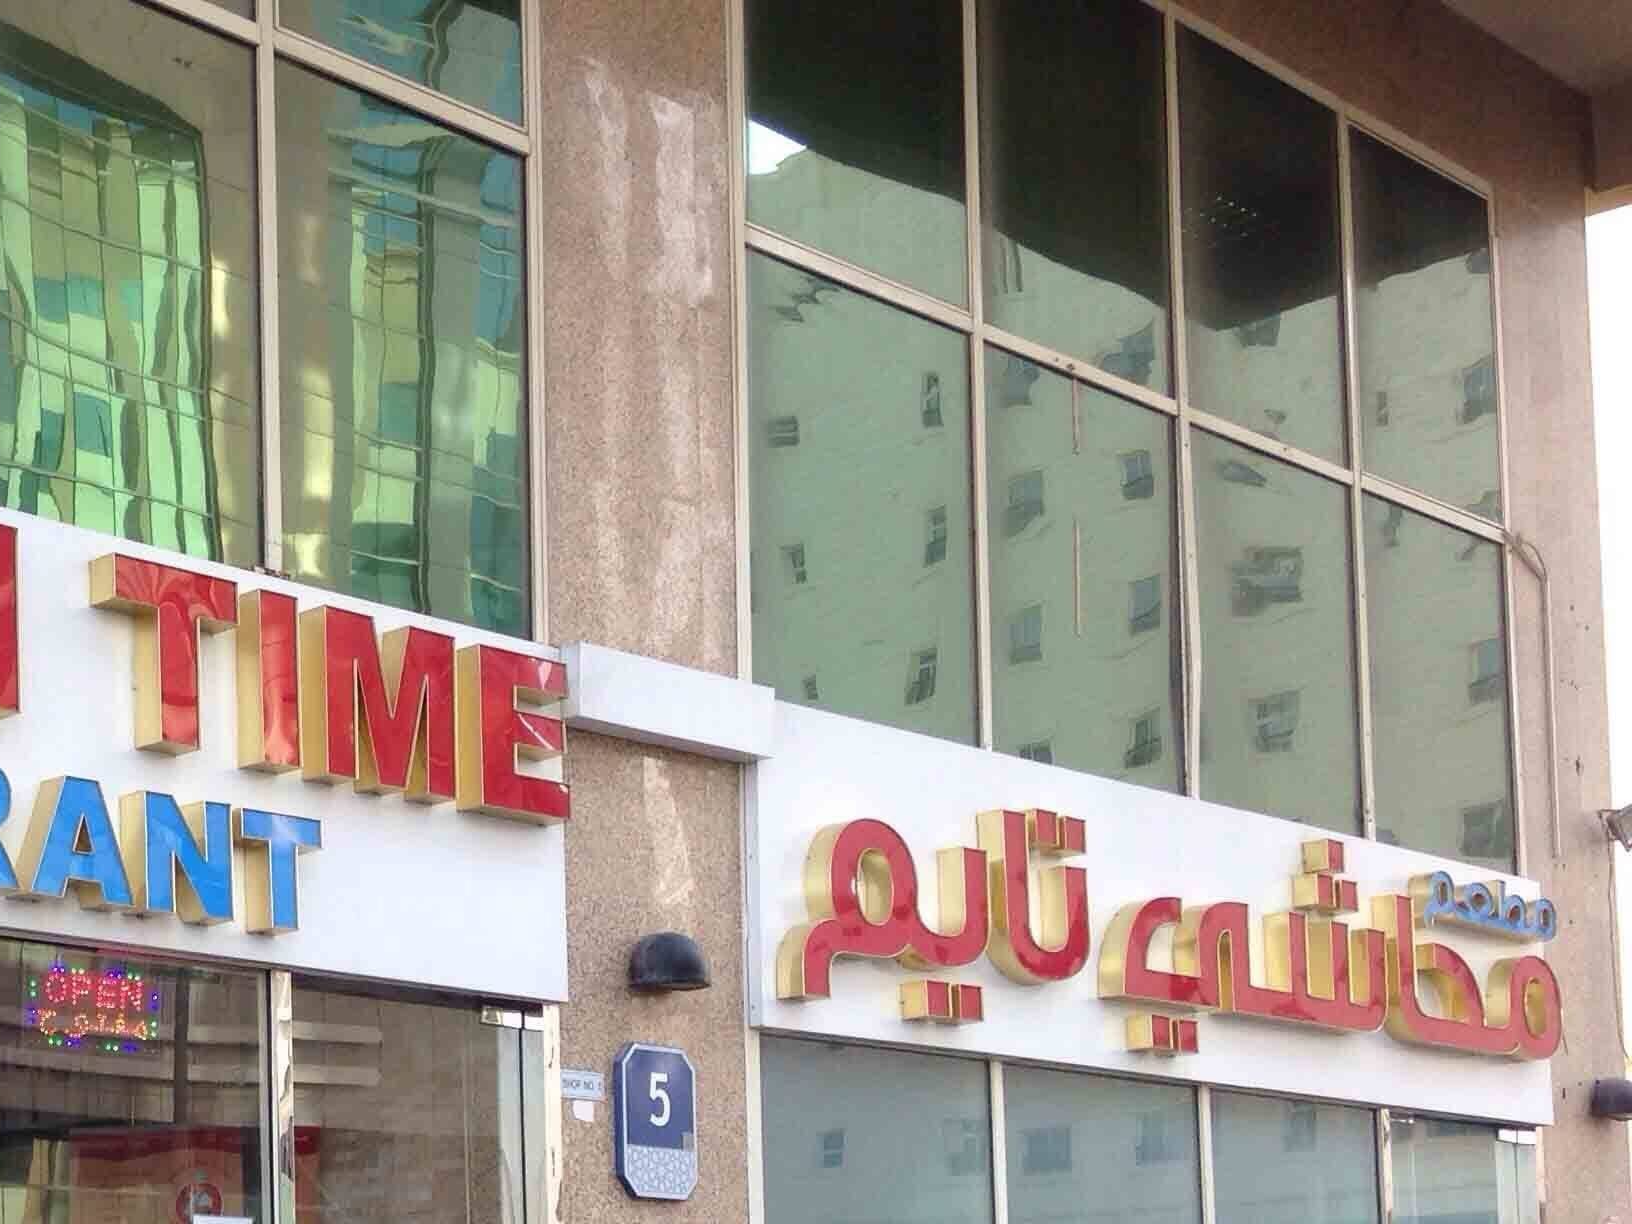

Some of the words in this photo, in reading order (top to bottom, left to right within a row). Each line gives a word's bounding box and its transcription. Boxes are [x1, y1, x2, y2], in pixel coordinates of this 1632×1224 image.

[90, 553, 570, 826] TIME
[777, 808, 1090, 1025] تايم
[1099, 838, 1564, 1060] محاشي
[1409, 870, 1558, 944] مطعم
[44, 974, 144, 1011] OPEN
[649, 1072, 671, 1128] 5
